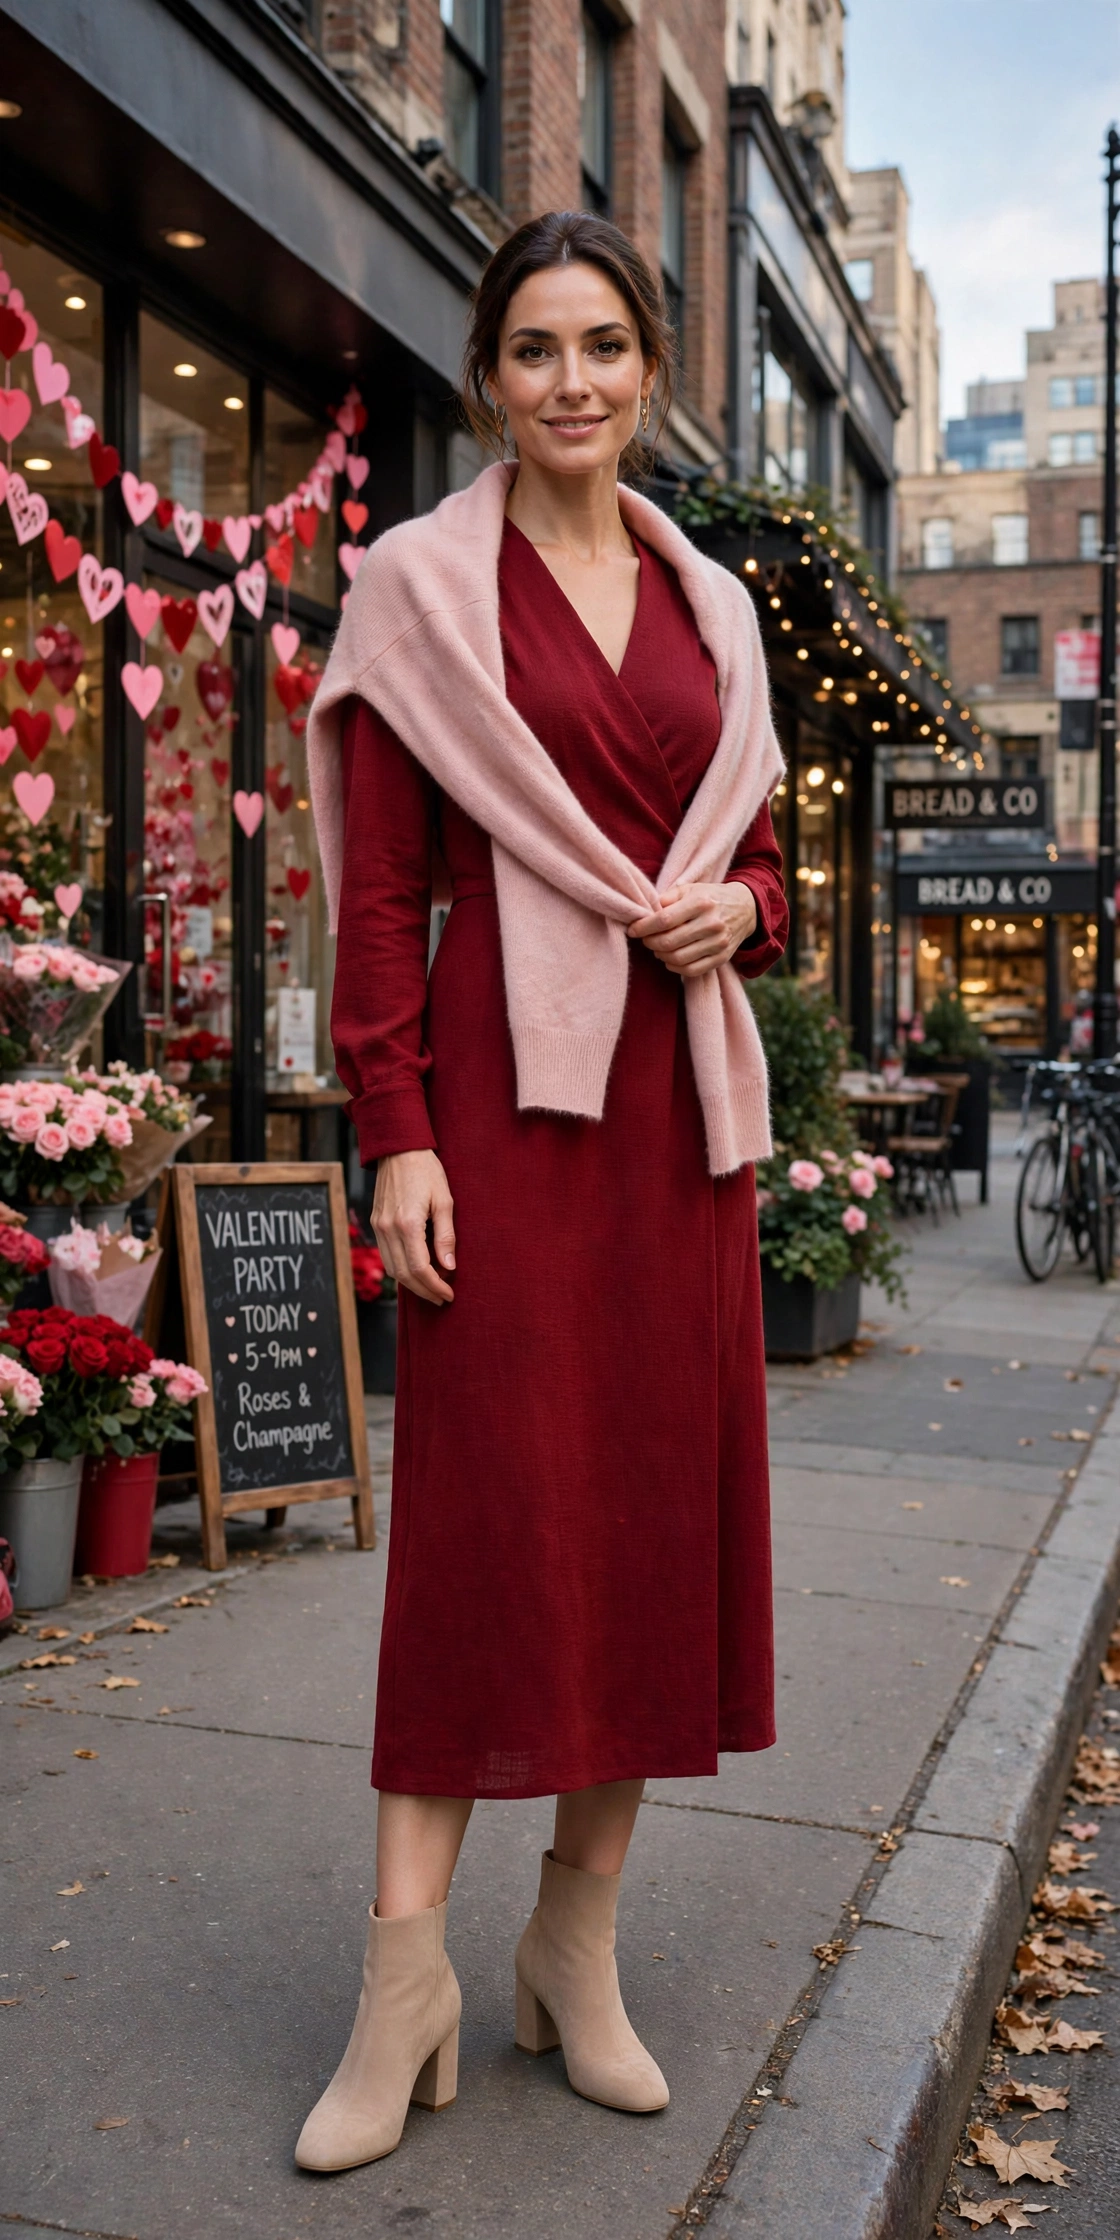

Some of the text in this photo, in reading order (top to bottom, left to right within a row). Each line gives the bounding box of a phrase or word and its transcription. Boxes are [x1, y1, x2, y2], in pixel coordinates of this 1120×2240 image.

[892, 786, 1038, 817] BREAD & CO
[918, 876, 1052, 905] BREAD & CO
[205, 1209, 324, 1249] VALENTINE
[233, 1254, 304, 1295] PARTY
[240, 1303, 302, 1334] TODAY
[237, 1382, 312, 1417] Roses &
[233, 1419, 334, 1457] Champagne
